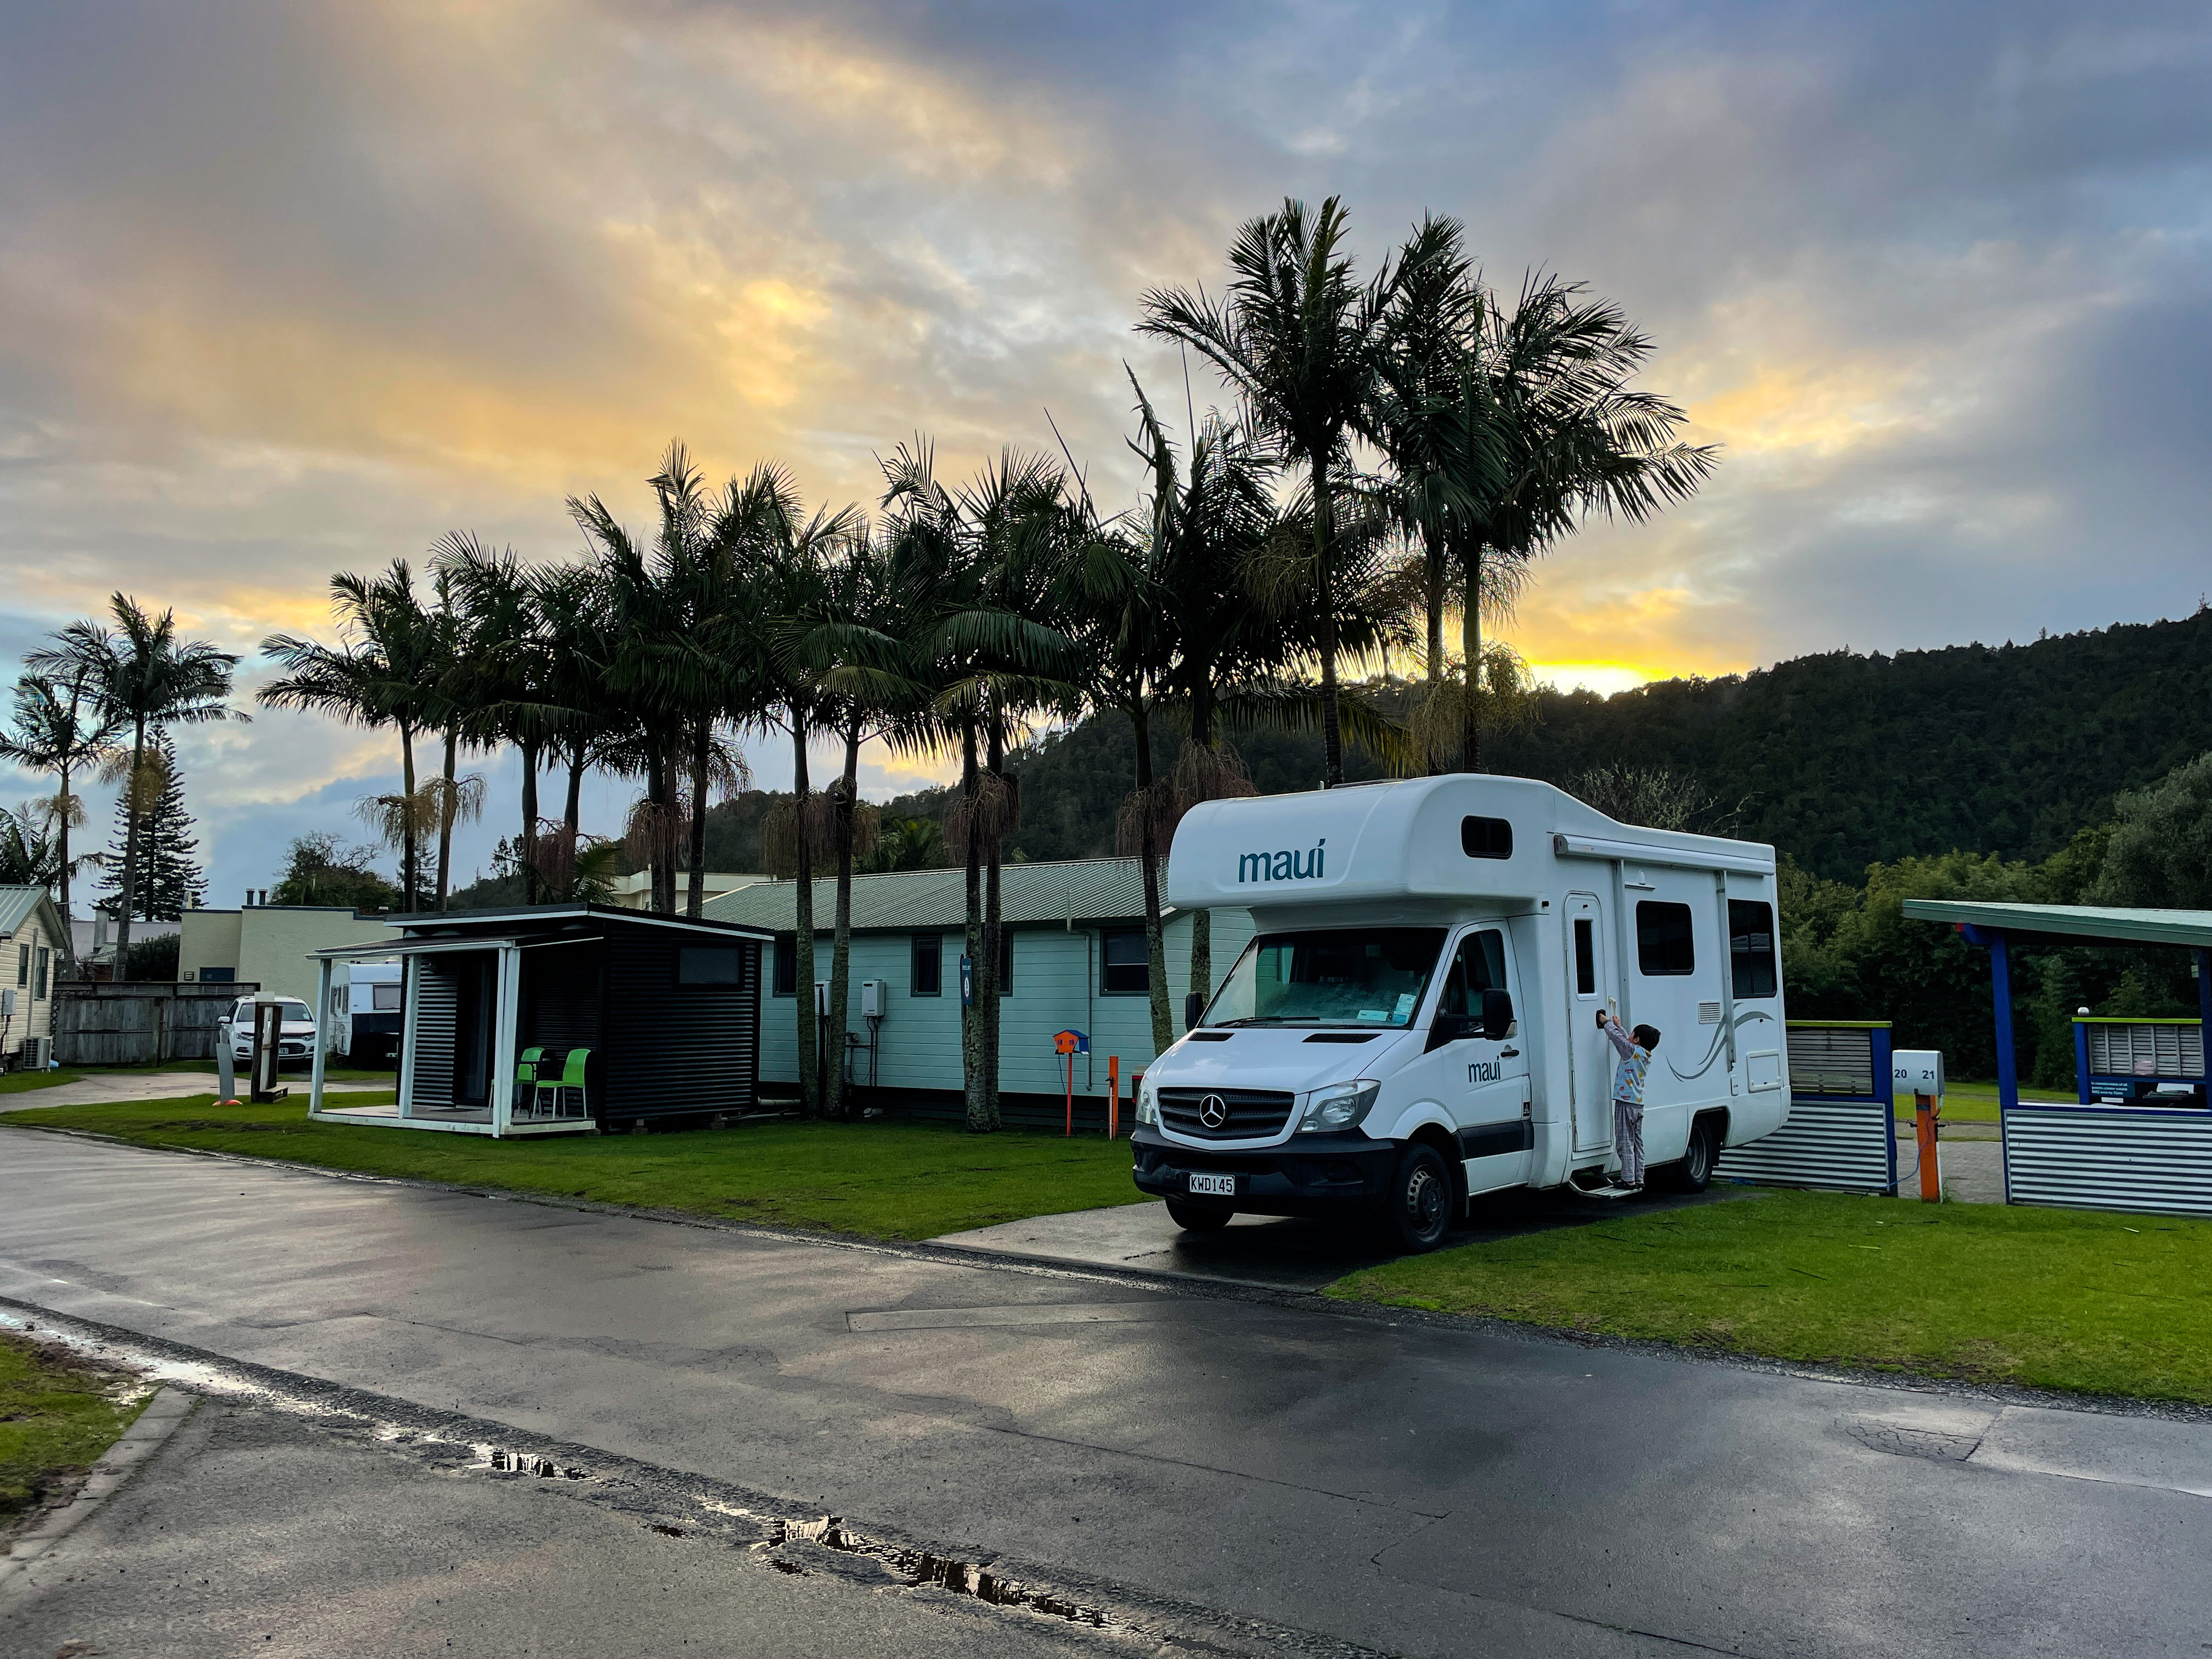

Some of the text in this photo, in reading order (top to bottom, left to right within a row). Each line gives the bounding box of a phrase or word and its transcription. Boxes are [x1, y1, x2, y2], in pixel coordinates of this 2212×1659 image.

[1894, 1069, 1934, 1079] 20 21
[1191, 1176, 1233, 1193] KWD145
